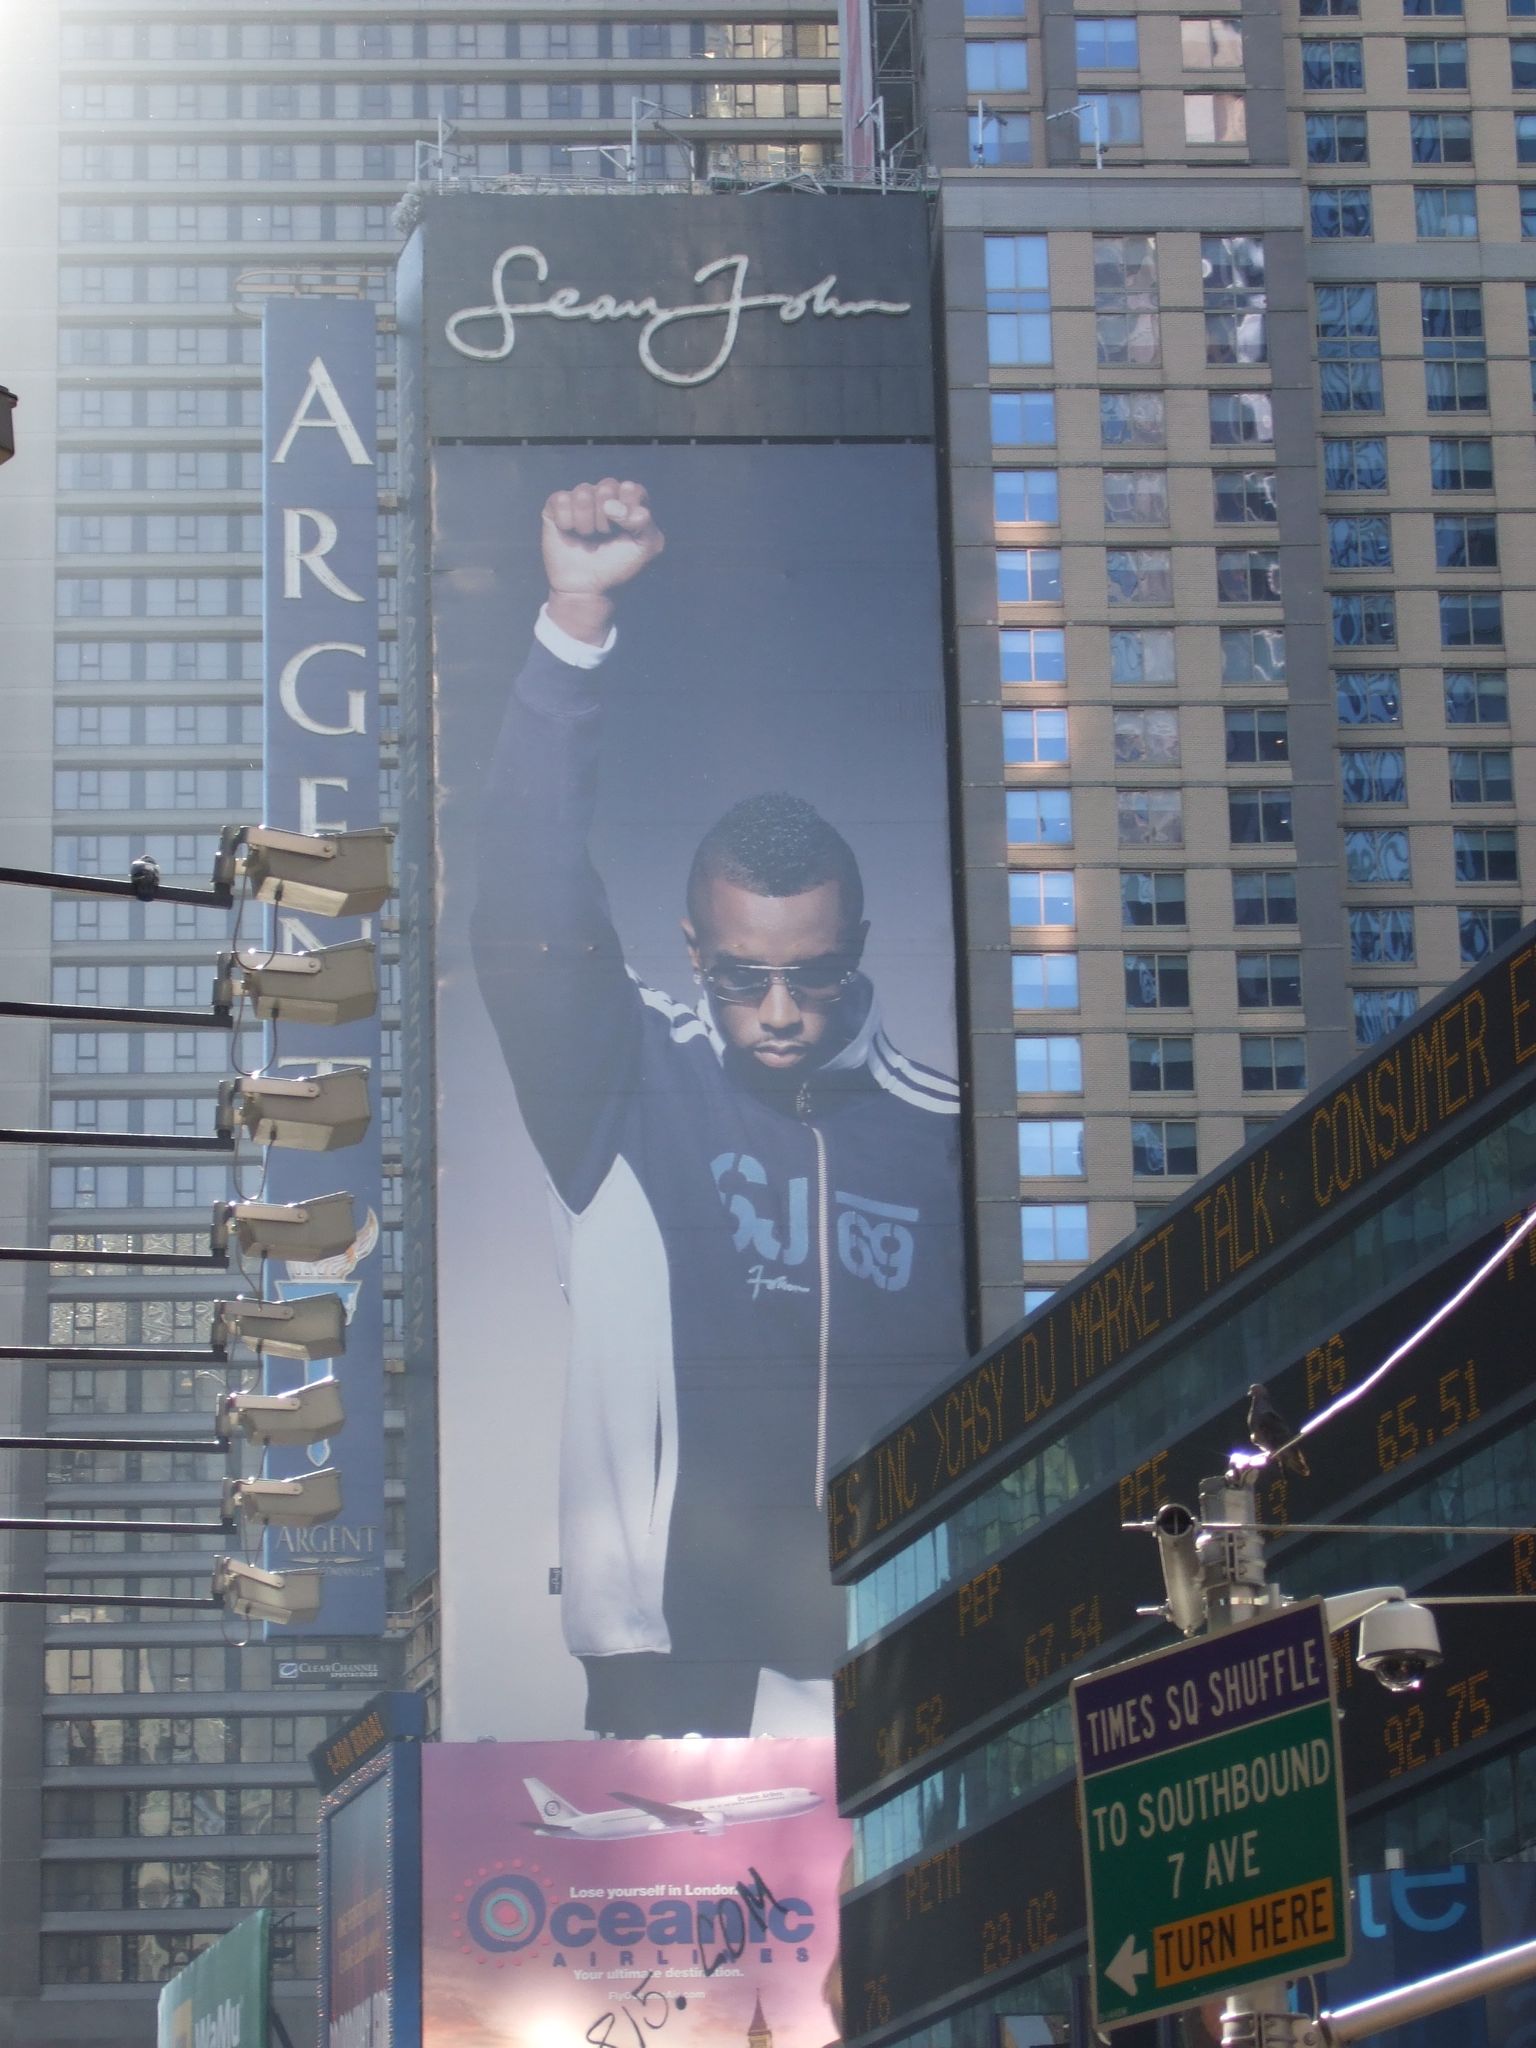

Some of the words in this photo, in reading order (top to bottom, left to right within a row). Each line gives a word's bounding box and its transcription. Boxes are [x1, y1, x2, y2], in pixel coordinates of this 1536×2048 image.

[446, 245, 660, 361] Sean
[638, 255, 912, 386] John
[1071, 1223, 1175, 1388] MARKET
[1311, 989, 1491, 1207] CONSUMER
[1305, 1333, 1346, 1411] PG
[275, 1525, 378, 1553] ARGENT
[1086, 1693, 1156, 1757] TIMES
[1167, 1679, 1200, 1731] SQ
[1208, 1638, 1320, 1716] SHUFFLE
[1093, 1801, 1128, 1852] TO
[1139, 1737, 1331, 1839] SOUTHBOUND
[569, 1887, 604, 1898] Lose
[607, 1885, 665, 1899] yourself
[668, 1885, 682, 1896] in
[1167, 1853, 1185, 1899] 7
[1204, 1830, 1261, 1890] AVE
[467, 1874, 815, 1953] Oceanic
[1159, 1914, 1236, 1977] TURN
[1250, 1886, 1330, 1953] HERE
[574, 1970, 603, 1981] Your
[665, 1968, 744, 1978] destintion.
